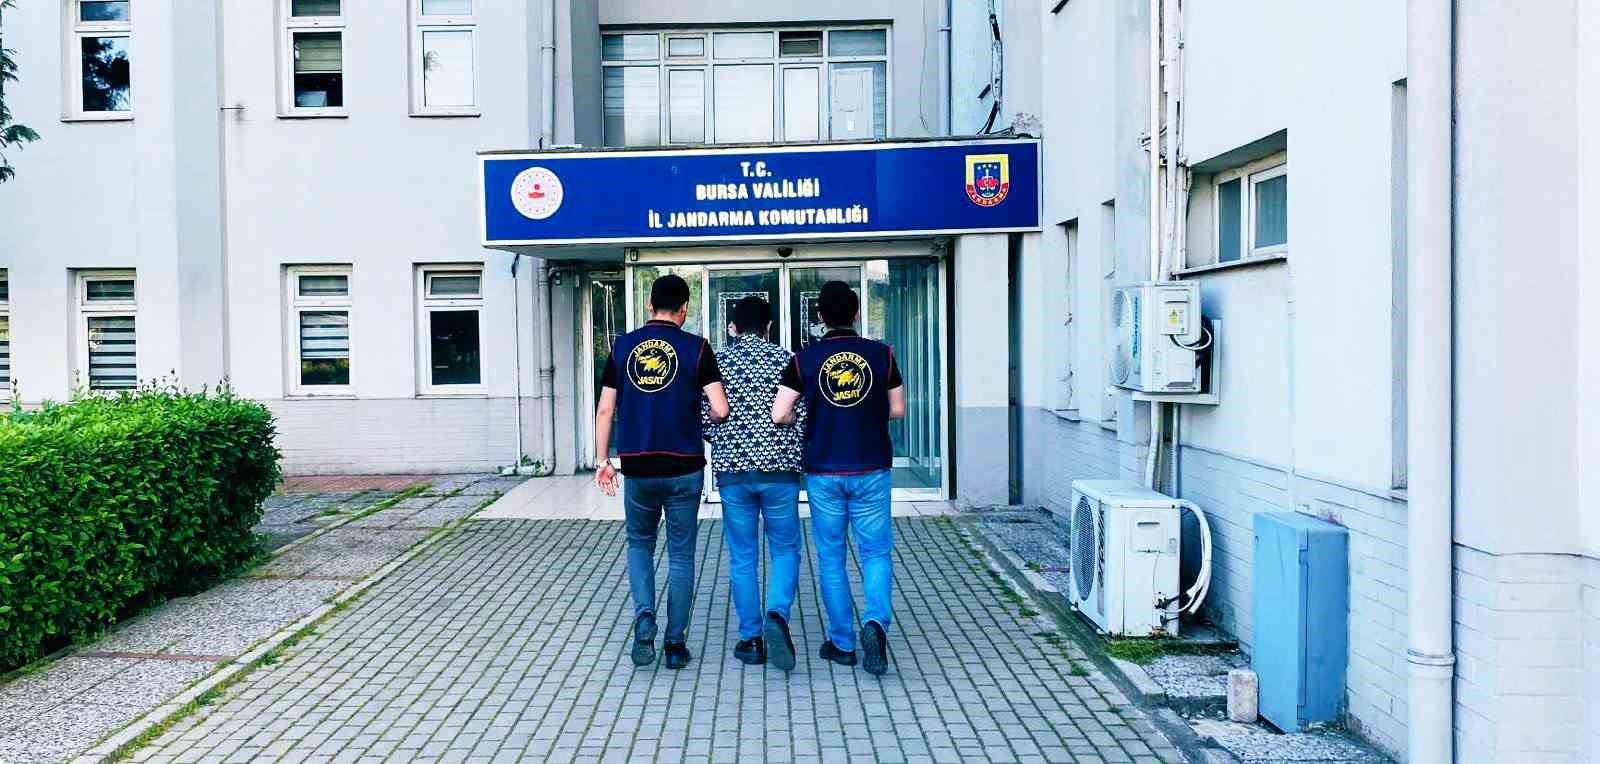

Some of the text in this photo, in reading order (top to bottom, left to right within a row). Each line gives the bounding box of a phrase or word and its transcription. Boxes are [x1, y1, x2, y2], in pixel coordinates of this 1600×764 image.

[740, 161, 772, 177] T.C.
[695, 183, 749, 201] BURSA
[648, 204, 869, 229] İL JANDARMA KOMUTANLIĞI
[634, 341, 676, 361] JANDARMA
[823, 353, 868, 375] JANDARMA
[637, 376, 665, 385] JASAT
[832, 389, 861, 402] JASAT
